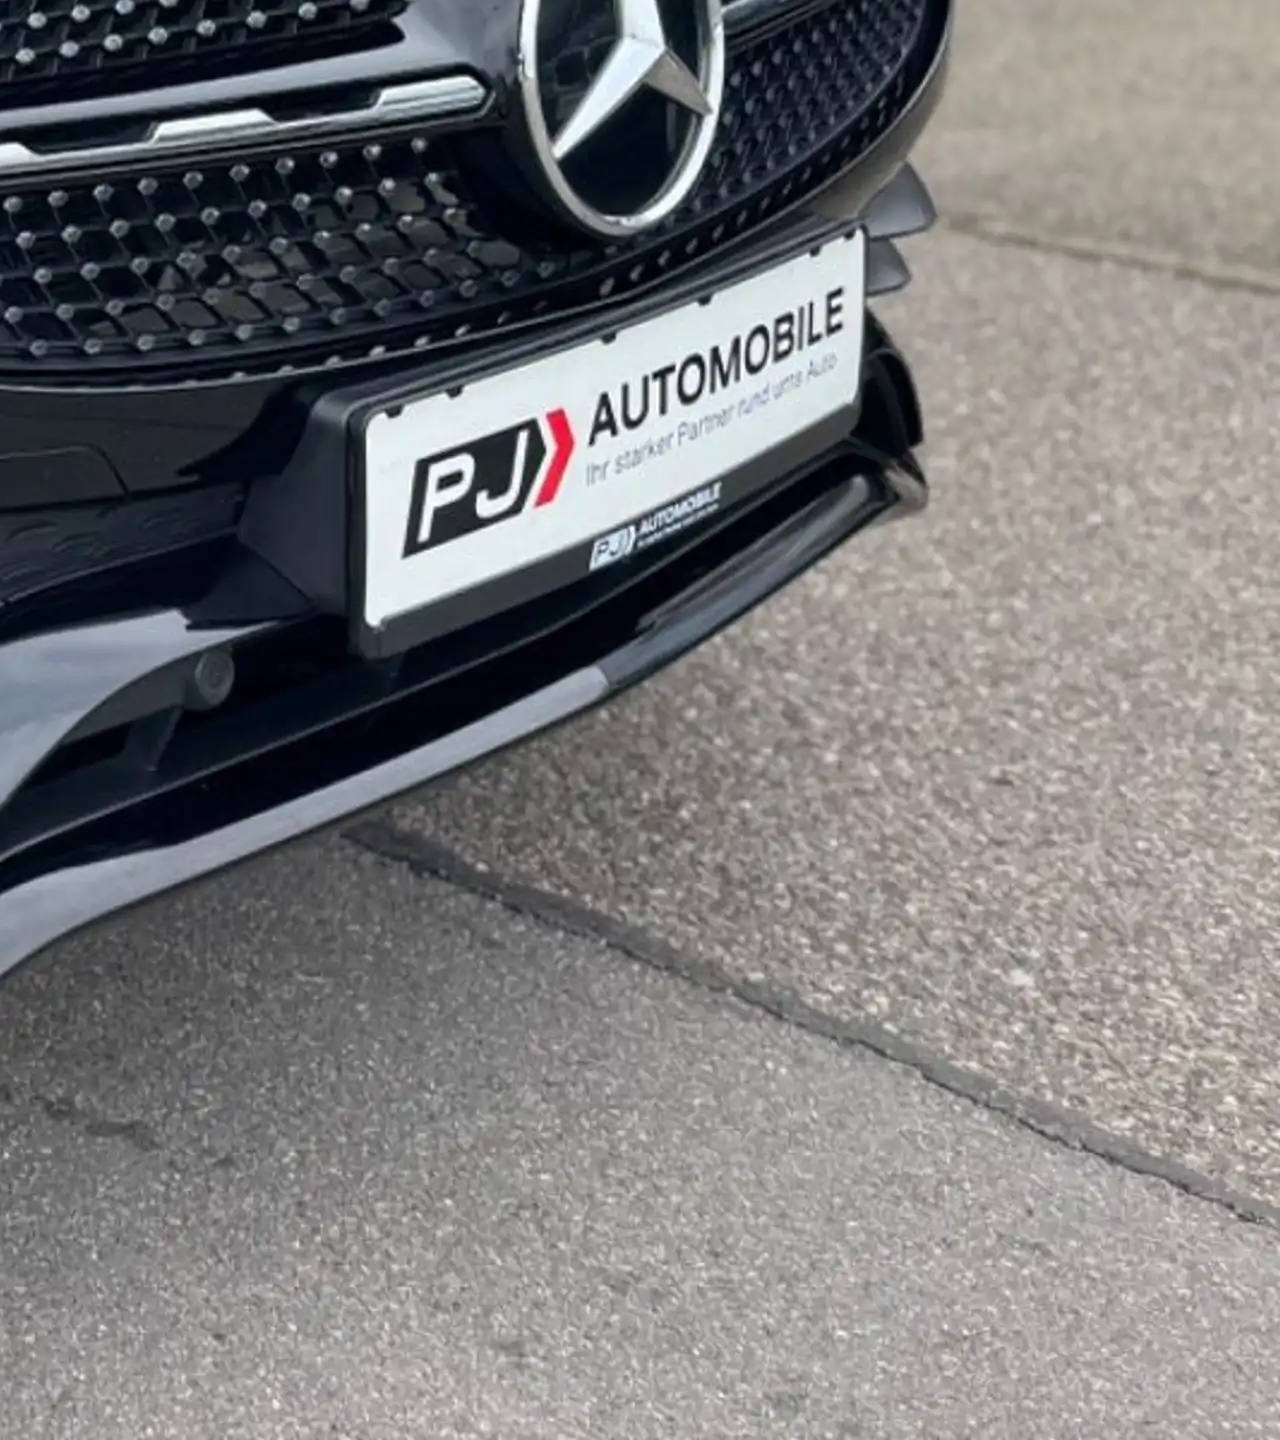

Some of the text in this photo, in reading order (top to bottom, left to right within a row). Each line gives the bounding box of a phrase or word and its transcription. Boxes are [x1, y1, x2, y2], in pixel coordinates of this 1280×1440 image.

[586, 459, 610, 487] Ihr
[614, 431, 675, 474] starker
[677, 404, 735, 447] Partner
[737, 380, 771, 416] rund
[806, 352, 838, 389] Auto
[588, 287, 844, 447] AUTOMOBILE
[417, 428, 529, 543] PJ
[640, 480, 722, 534] AUTOMOBILE
